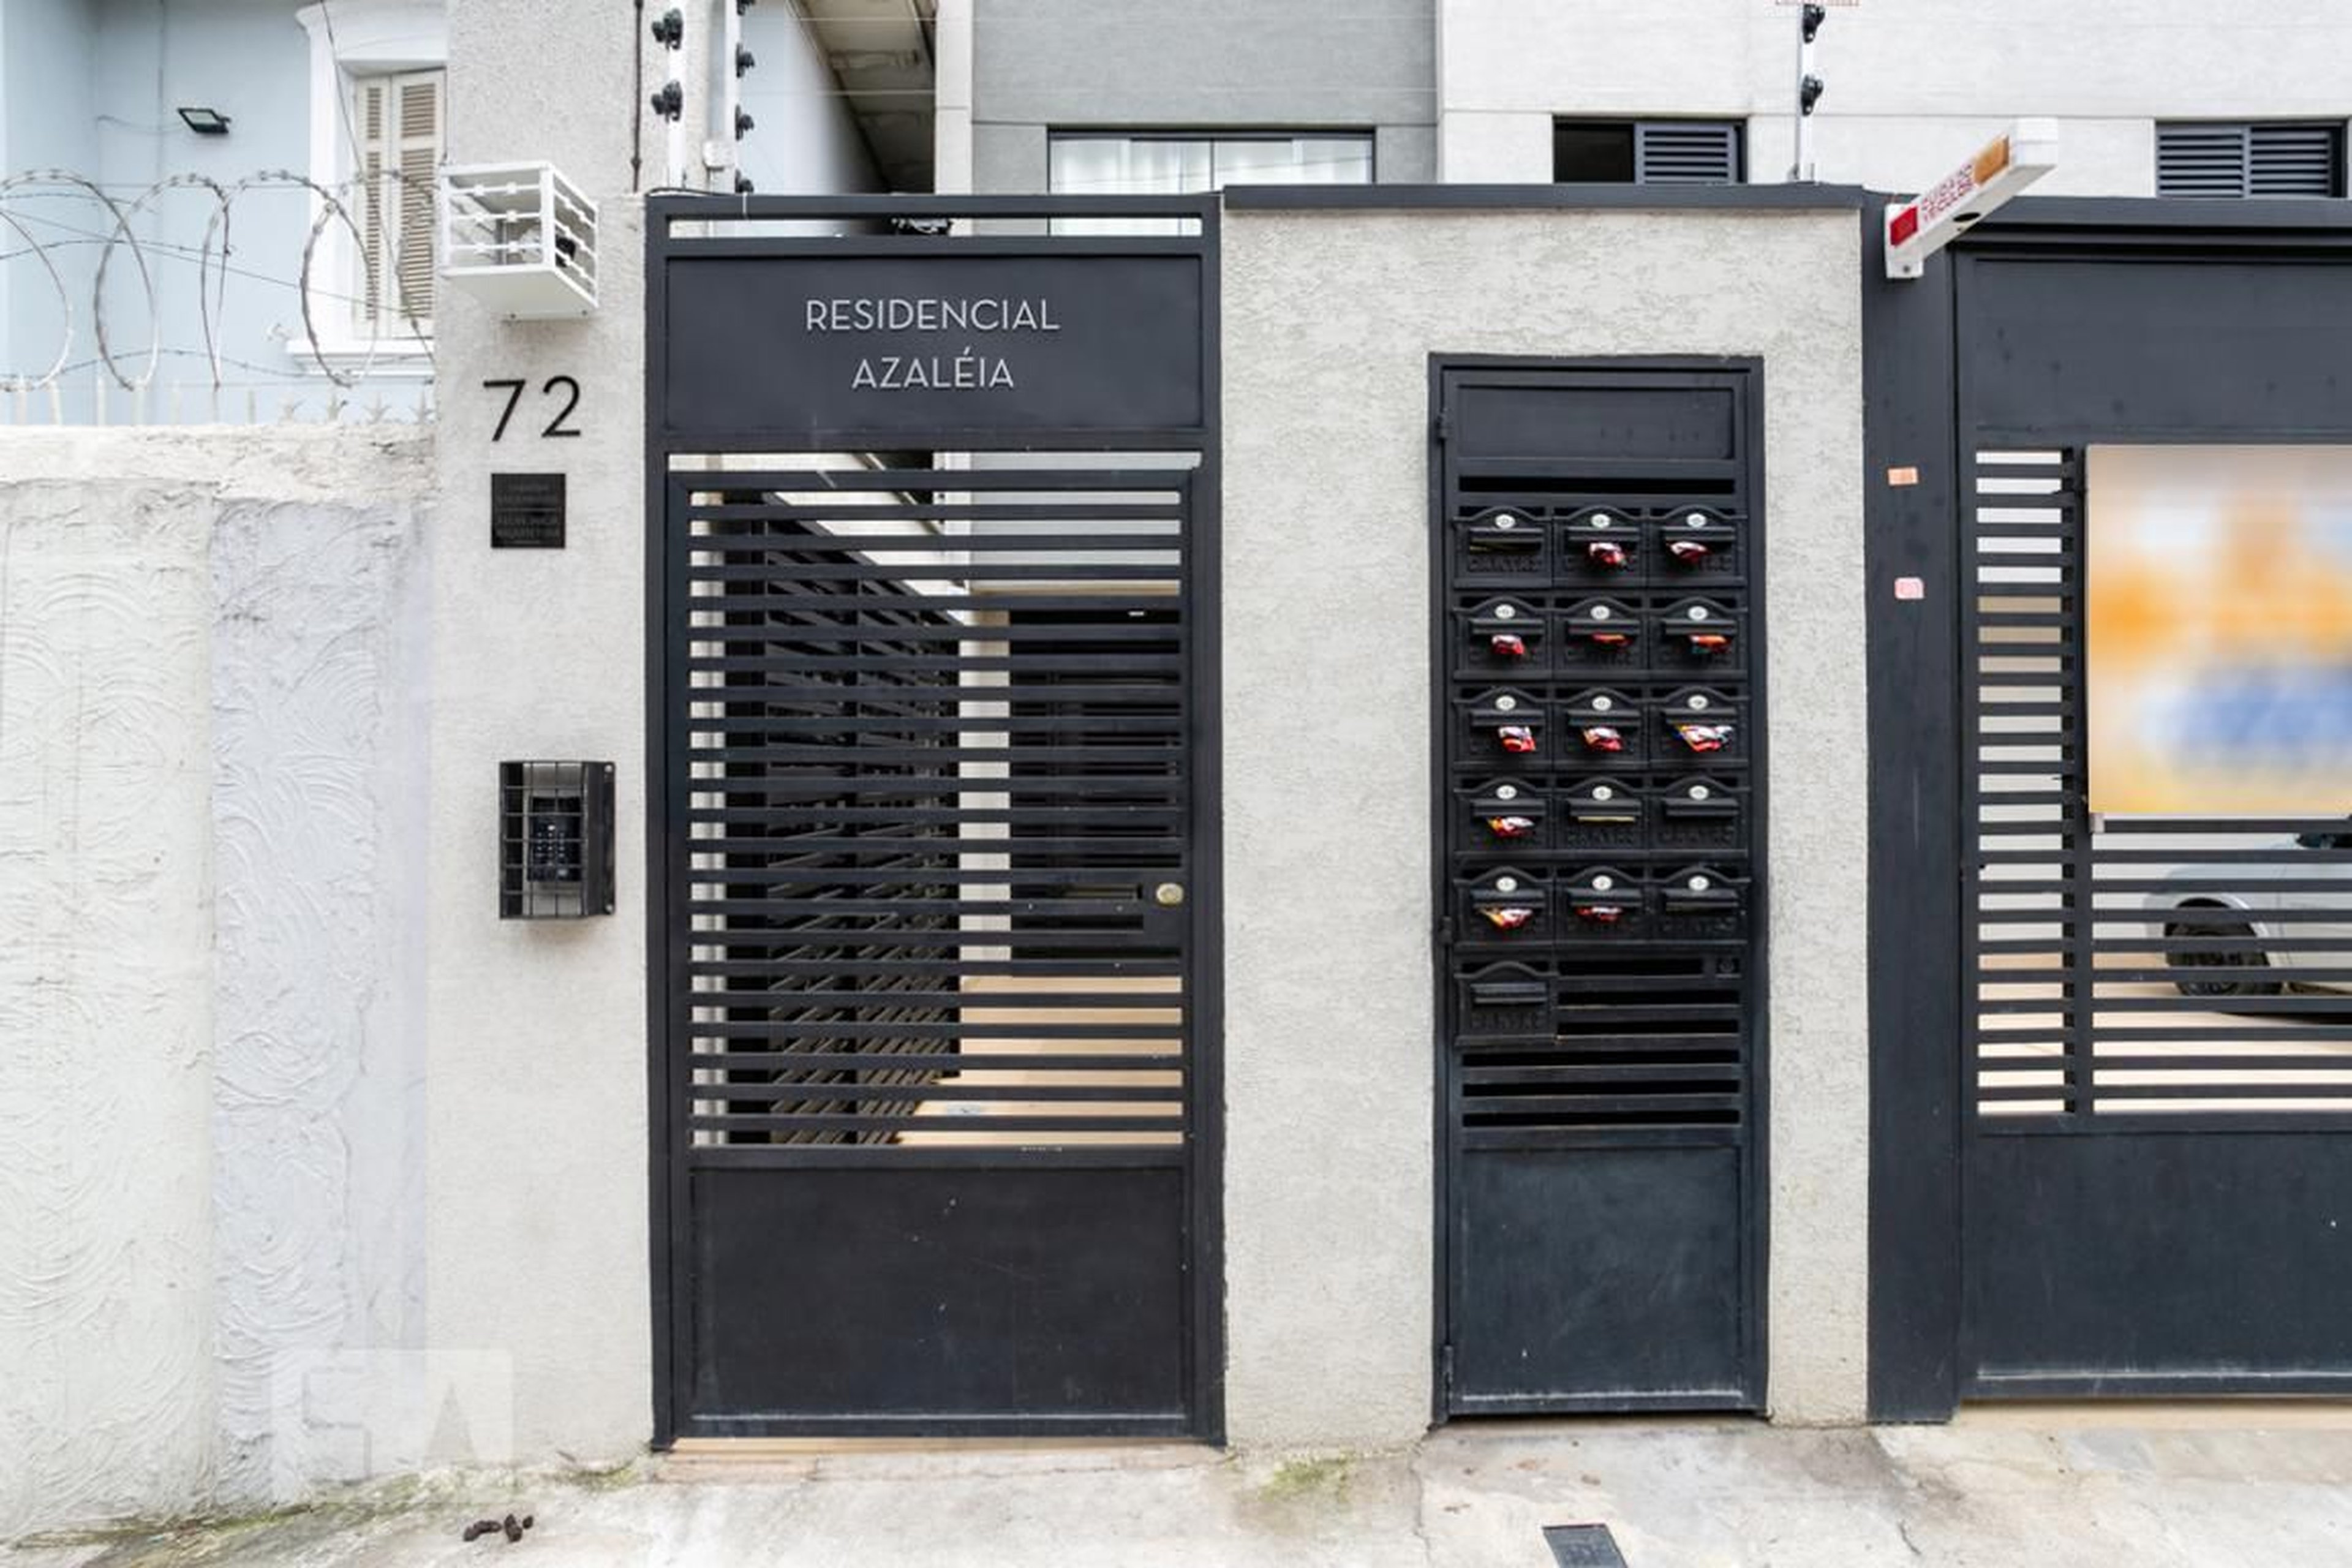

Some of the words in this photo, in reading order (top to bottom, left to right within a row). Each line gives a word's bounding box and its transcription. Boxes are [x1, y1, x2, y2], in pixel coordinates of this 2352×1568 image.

[806, 299, 1061, 331] RESIDENCIAL
[851, 346, 1014, 389] AZALÉIA
[483, 375, 581, 442] 72
